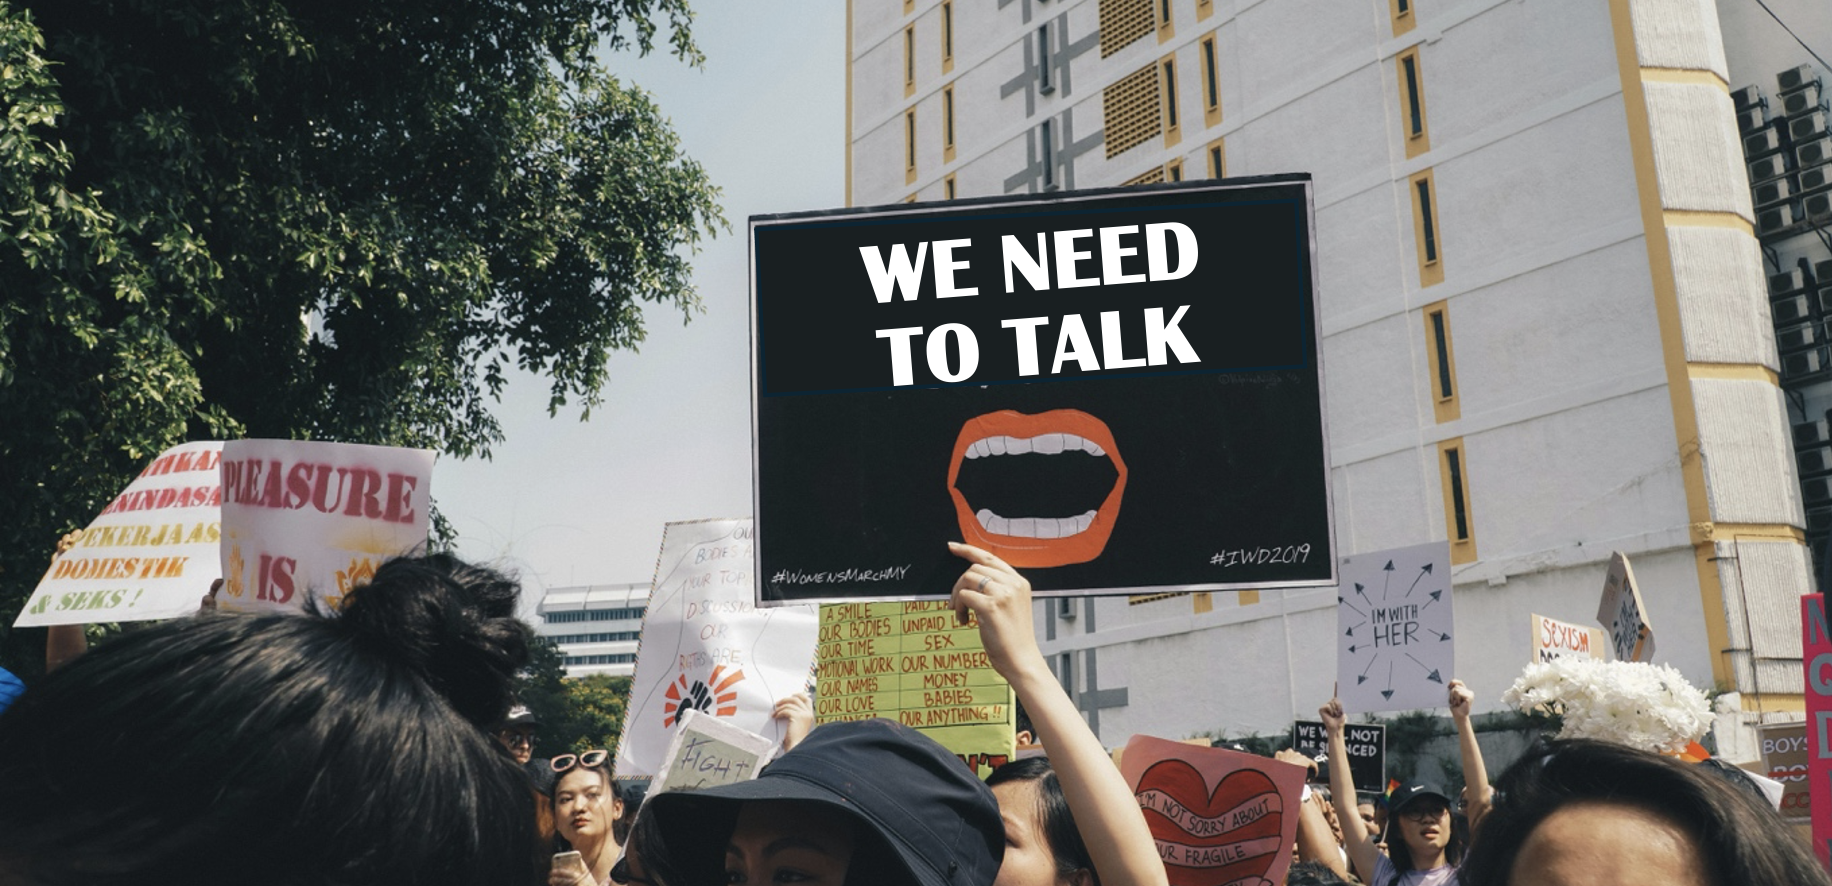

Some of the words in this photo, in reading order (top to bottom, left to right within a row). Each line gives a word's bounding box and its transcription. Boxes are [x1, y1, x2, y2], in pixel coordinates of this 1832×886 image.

[859, 238, 979, 303] WE
[1001, 221, 1199, 294] NEED
[876, 323, 980, 386] TO
[1001, 305, 1201, 377] TALK
[223, 458, 418, 524] PLEASURE
[733, 527, 753, 540] OU
[1209, 543, 1311, 567] #IWD2019
[256, 553, 298, 605] IS
[30, 594, 52, 615] &
[55, 589, 128, 611] SEKS
[826, 608, 834, 622] A
[838, 603, 872, 621] SMILE
[1388, 604, 1419, 622] WITH
[701, 624, 728, 640] OUR
[819, 624, 842, 642] OUR
[850, 618, 891, 638] BODIES
[903, 616, 945, 633] UNPAID
[1373, 621, 1420, 648] HER
[821, 643, 842, 659] OUR
[848, 639, 875, 656] TIME
[924, 634, 954, 651] SEX
[863, 657, 894, 675] WORK
[902, 655, 929, 672] OUR
[933, 652, 993, 670] NUMBER
[822, 680, 842, 697] OUR
[847, 678, 878, 694] NAMES
[923, 672, 967, 689] MONEY
[819, 699, 842, 715] OUR
[846, 696, 874, 713] LOVE
[924, 689, 973, 707] BABIES
[900, 709, 923, 726] OUR
[927, 706, 988, 726] ANYTHING
[1298, 726, 1316, 738] WE
[1351, 729, 1380, 743] NOT
[681, 738, 749, 781] FIGHT
[1163, 799, 1187, 823] NOT
[1187, 815, 1226, 835] SORRY
[1233, 798, 1268, 827] ABOUT
[1185, 845, 1246, 865] FRAGILE
